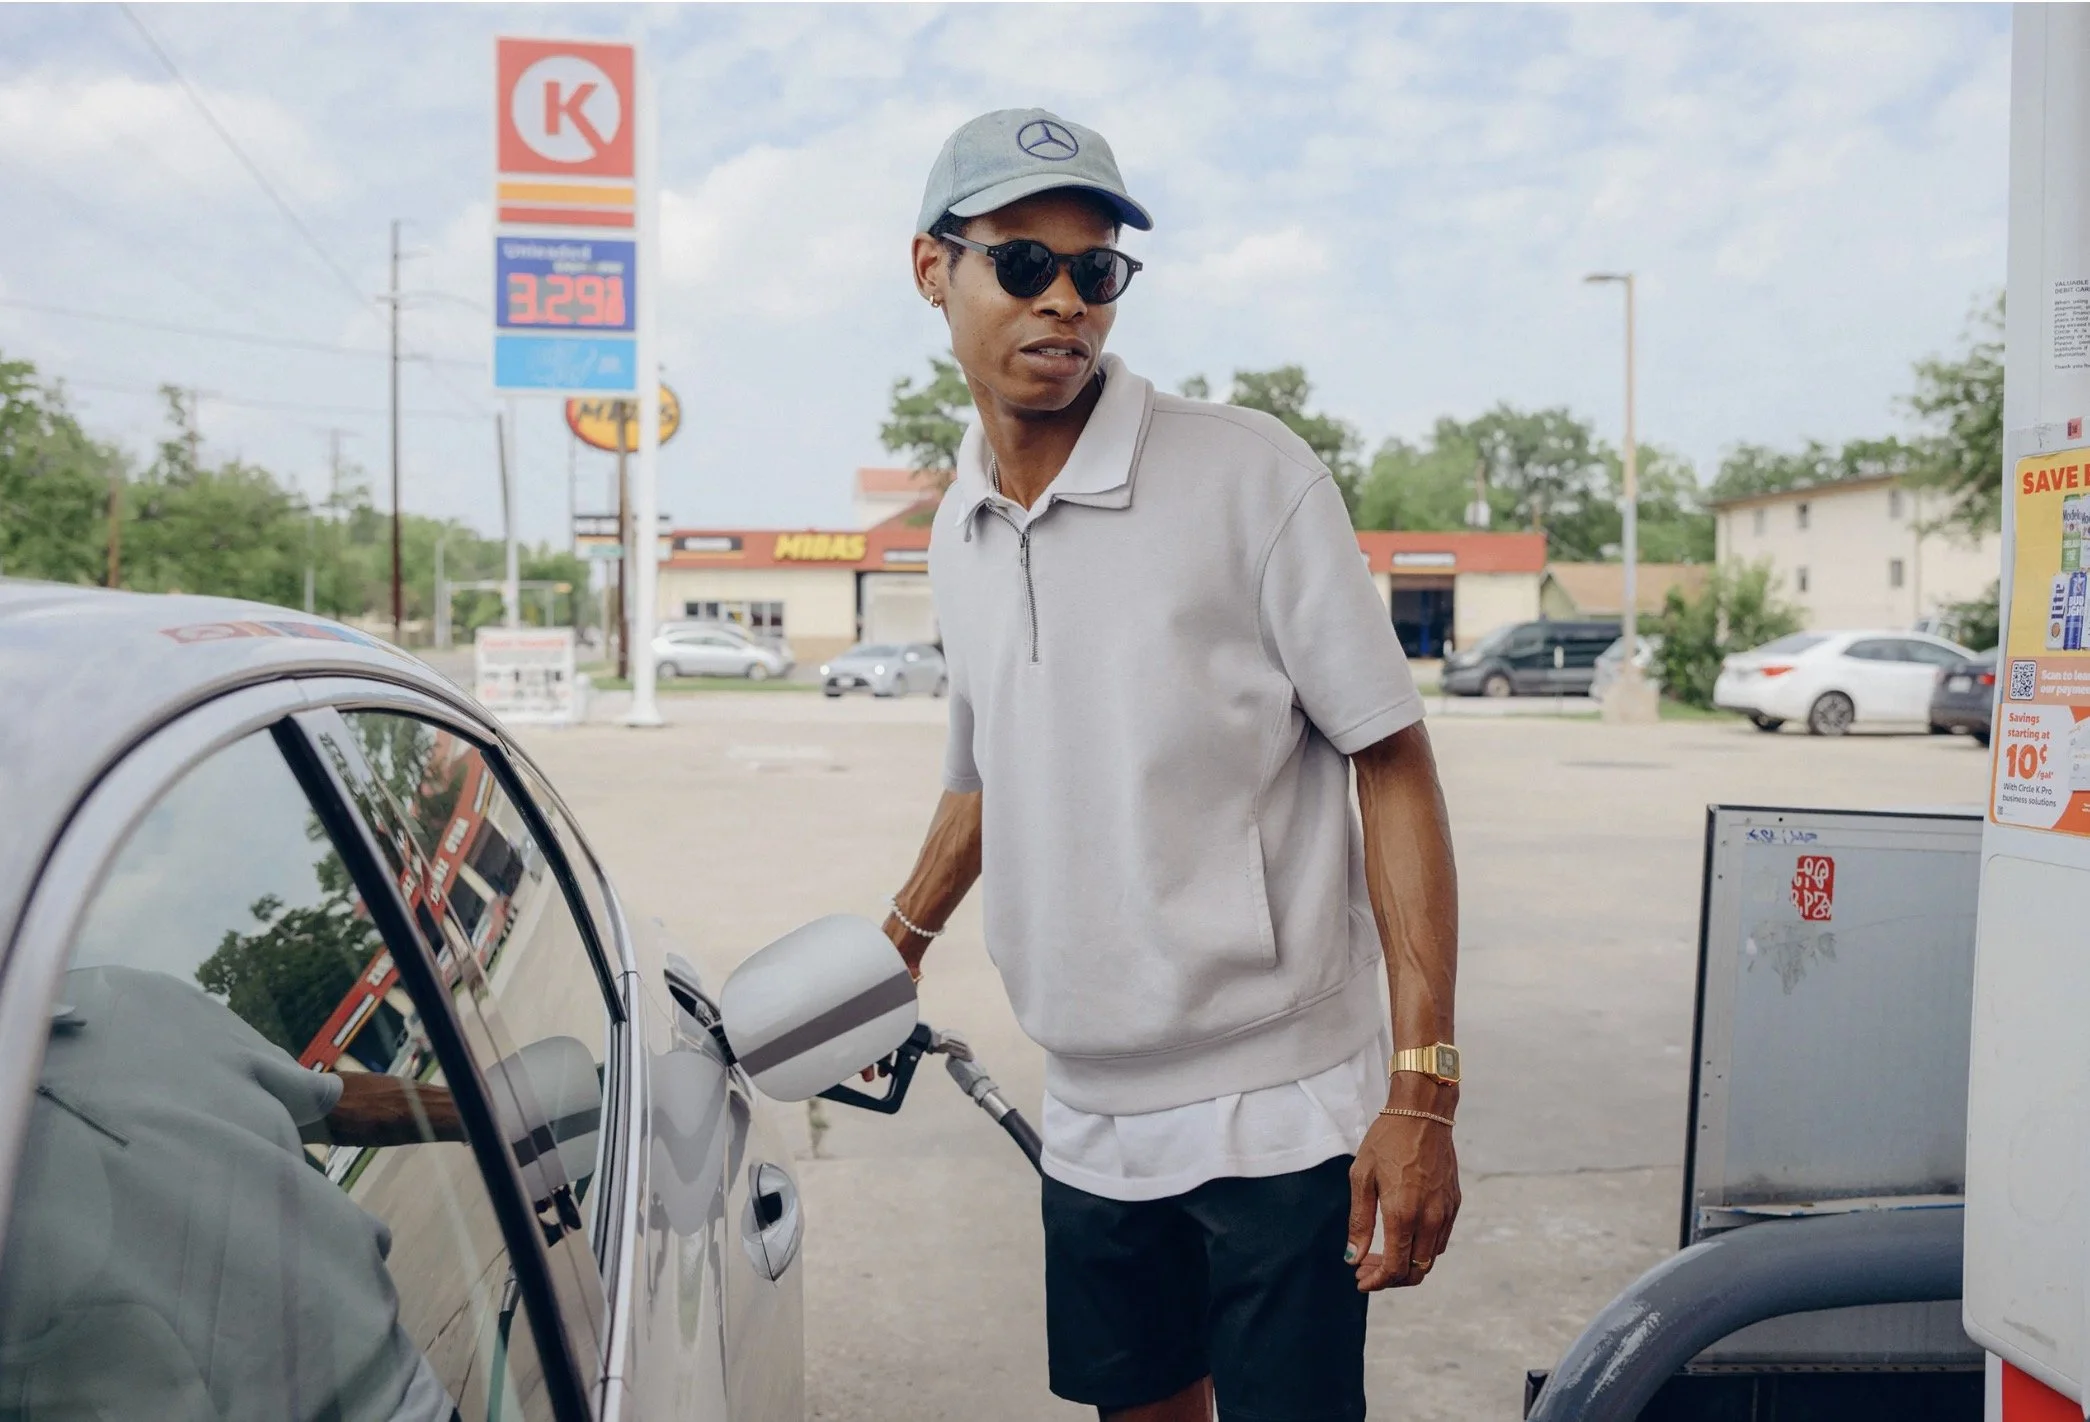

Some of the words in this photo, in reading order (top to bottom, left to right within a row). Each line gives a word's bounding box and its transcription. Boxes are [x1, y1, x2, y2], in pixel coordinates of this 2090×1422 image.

[2023, 465, 2078, 495] SAVE
[774, 533, 867, 561] MIDAS
[2068, 595, 2084, 606] BUD
[2041, 669, 2061, 681] Scan
[2063, 670, 2073, 680] to
[2040, 685, 2055, 694] our
[2009, 712, 2040, 725] Savings
[2008, 728, 2040, 741] starting
[2041, 731, 2050, 739] at
[2004, 782, 2017, 791] With
[2018, 784, 2035, 793] Circle
[2041, 786, 2052, 795] Pro
[2003, 794, 2027, 804] business
[2029, 797, 2056, 807] solutions
